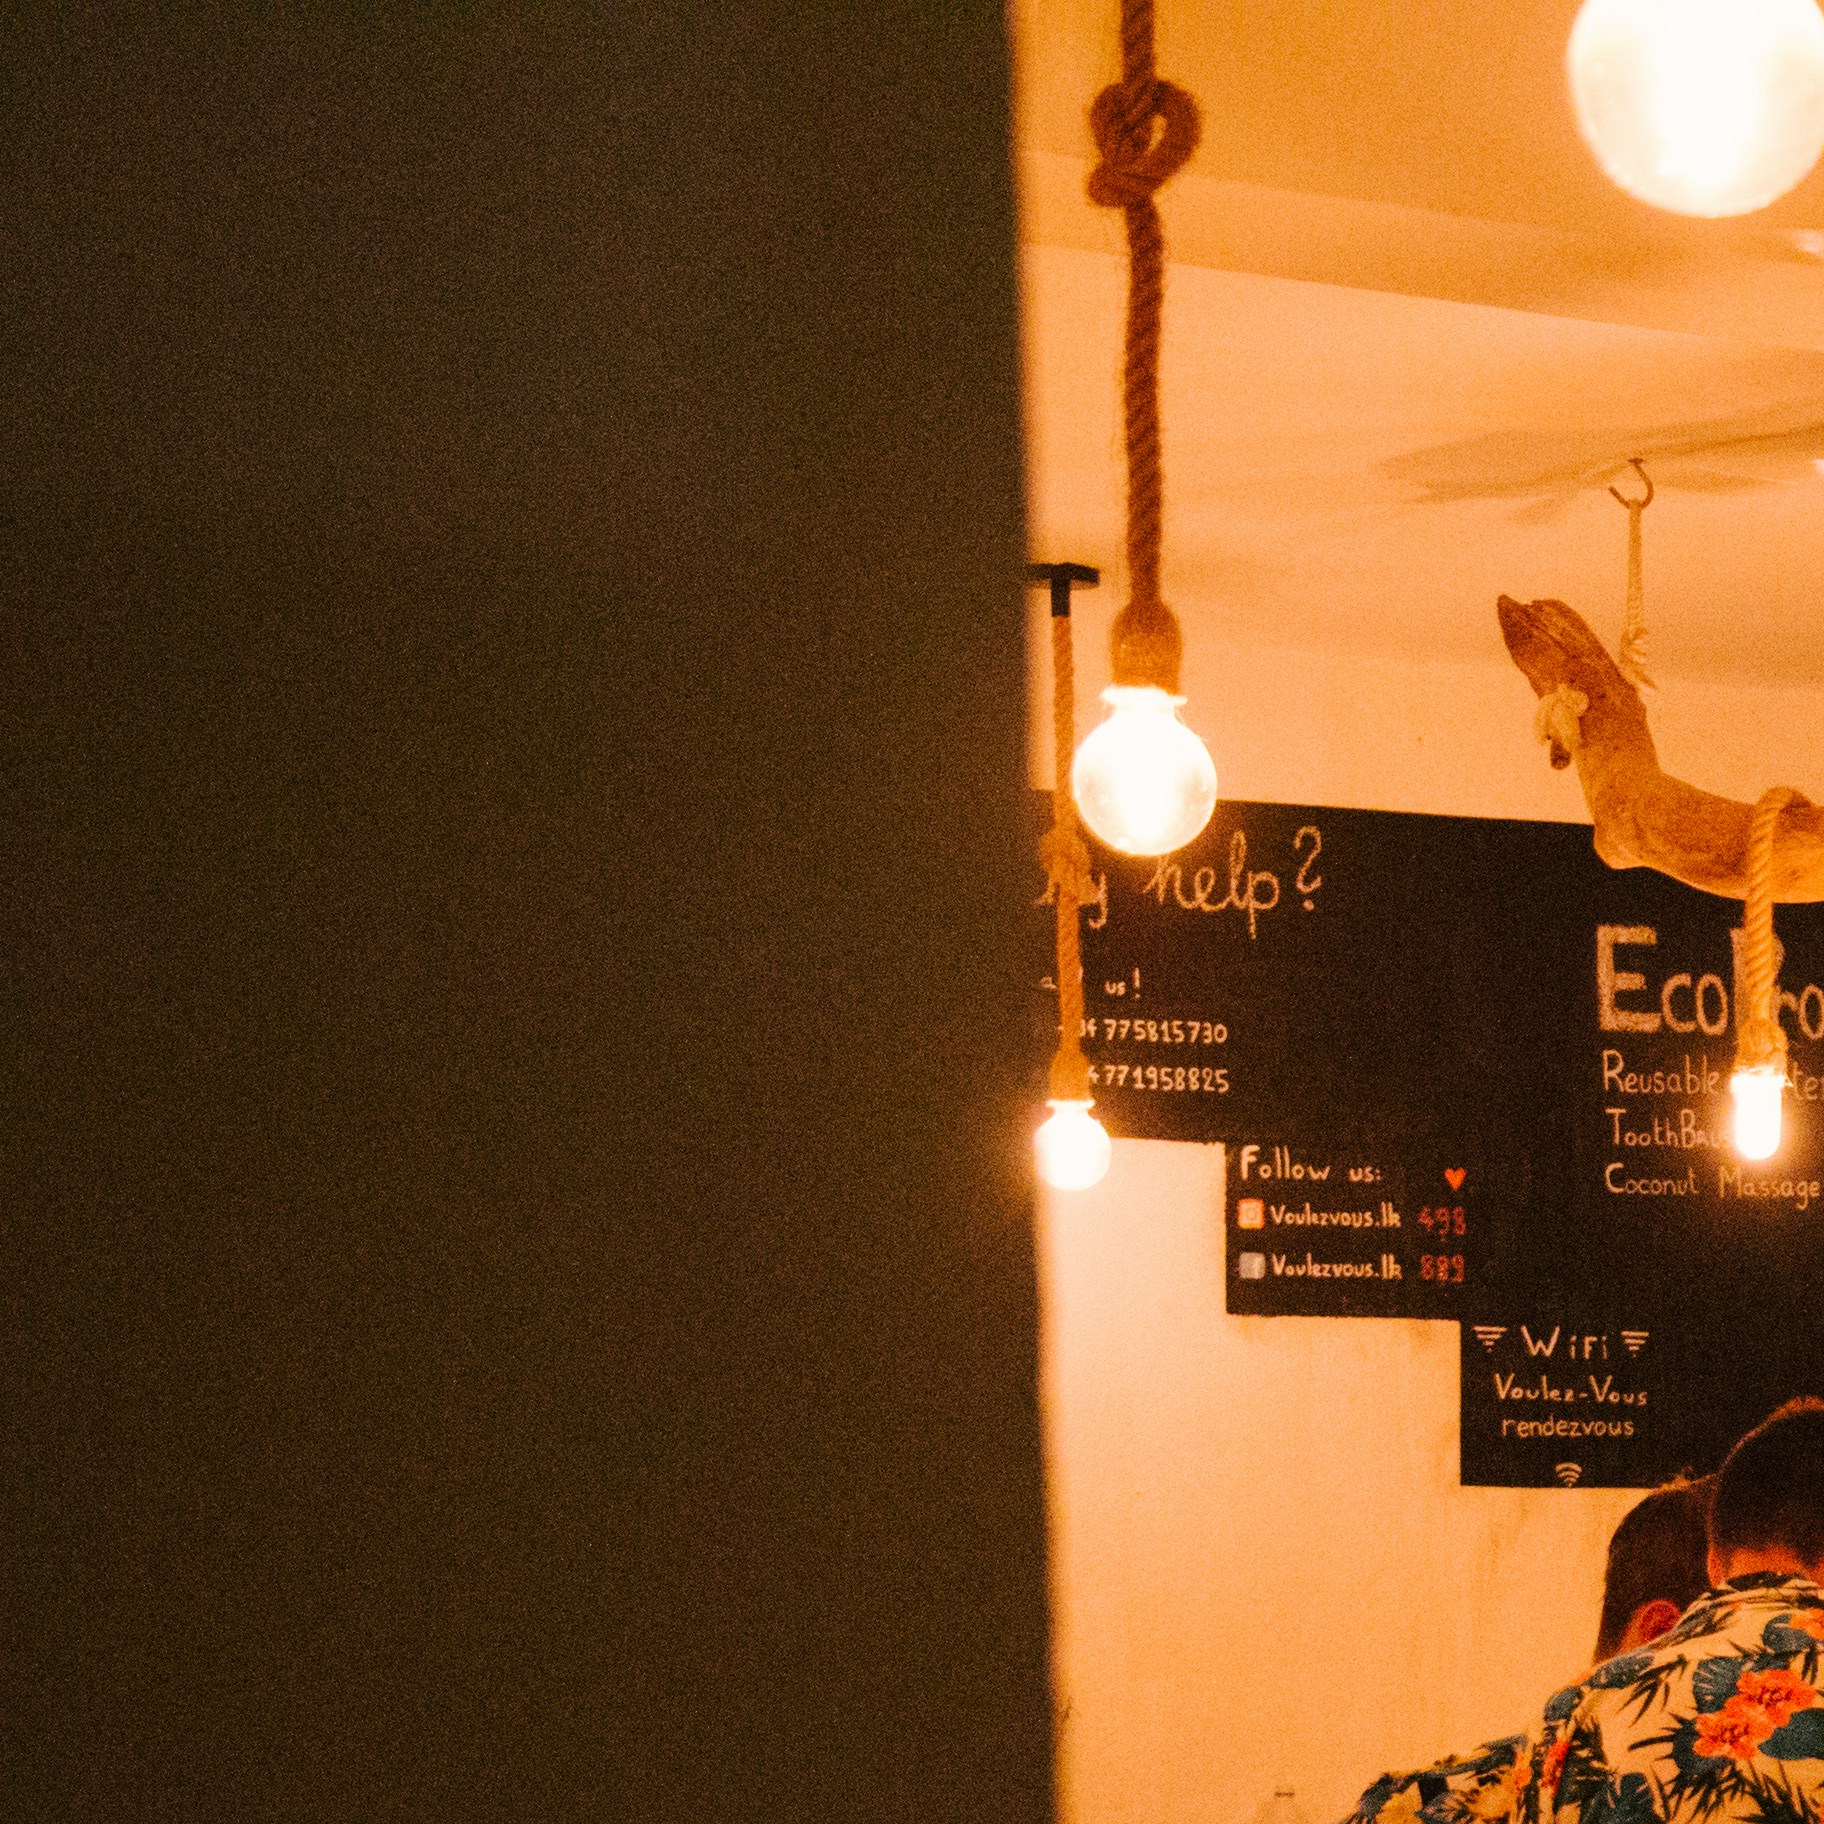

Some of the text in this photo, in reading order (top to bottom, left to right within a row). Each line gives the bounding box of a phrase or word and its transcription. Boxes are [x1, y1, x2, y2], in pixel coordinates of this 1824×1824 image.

[1602, 1049, 1721, 1095] Reusable
[1240, 1144, 1331, 1181] Follow
[1604, 1163, 1698, 1195] Coconut
[1719, 1166, 1821, 1210] Massage
[1520, 1325, 1610, 1361] WiFi
[1494, 1372, 1649, 1407] Voulez-Vous
[1501, 1415, 1636, 1439] rendezvous
